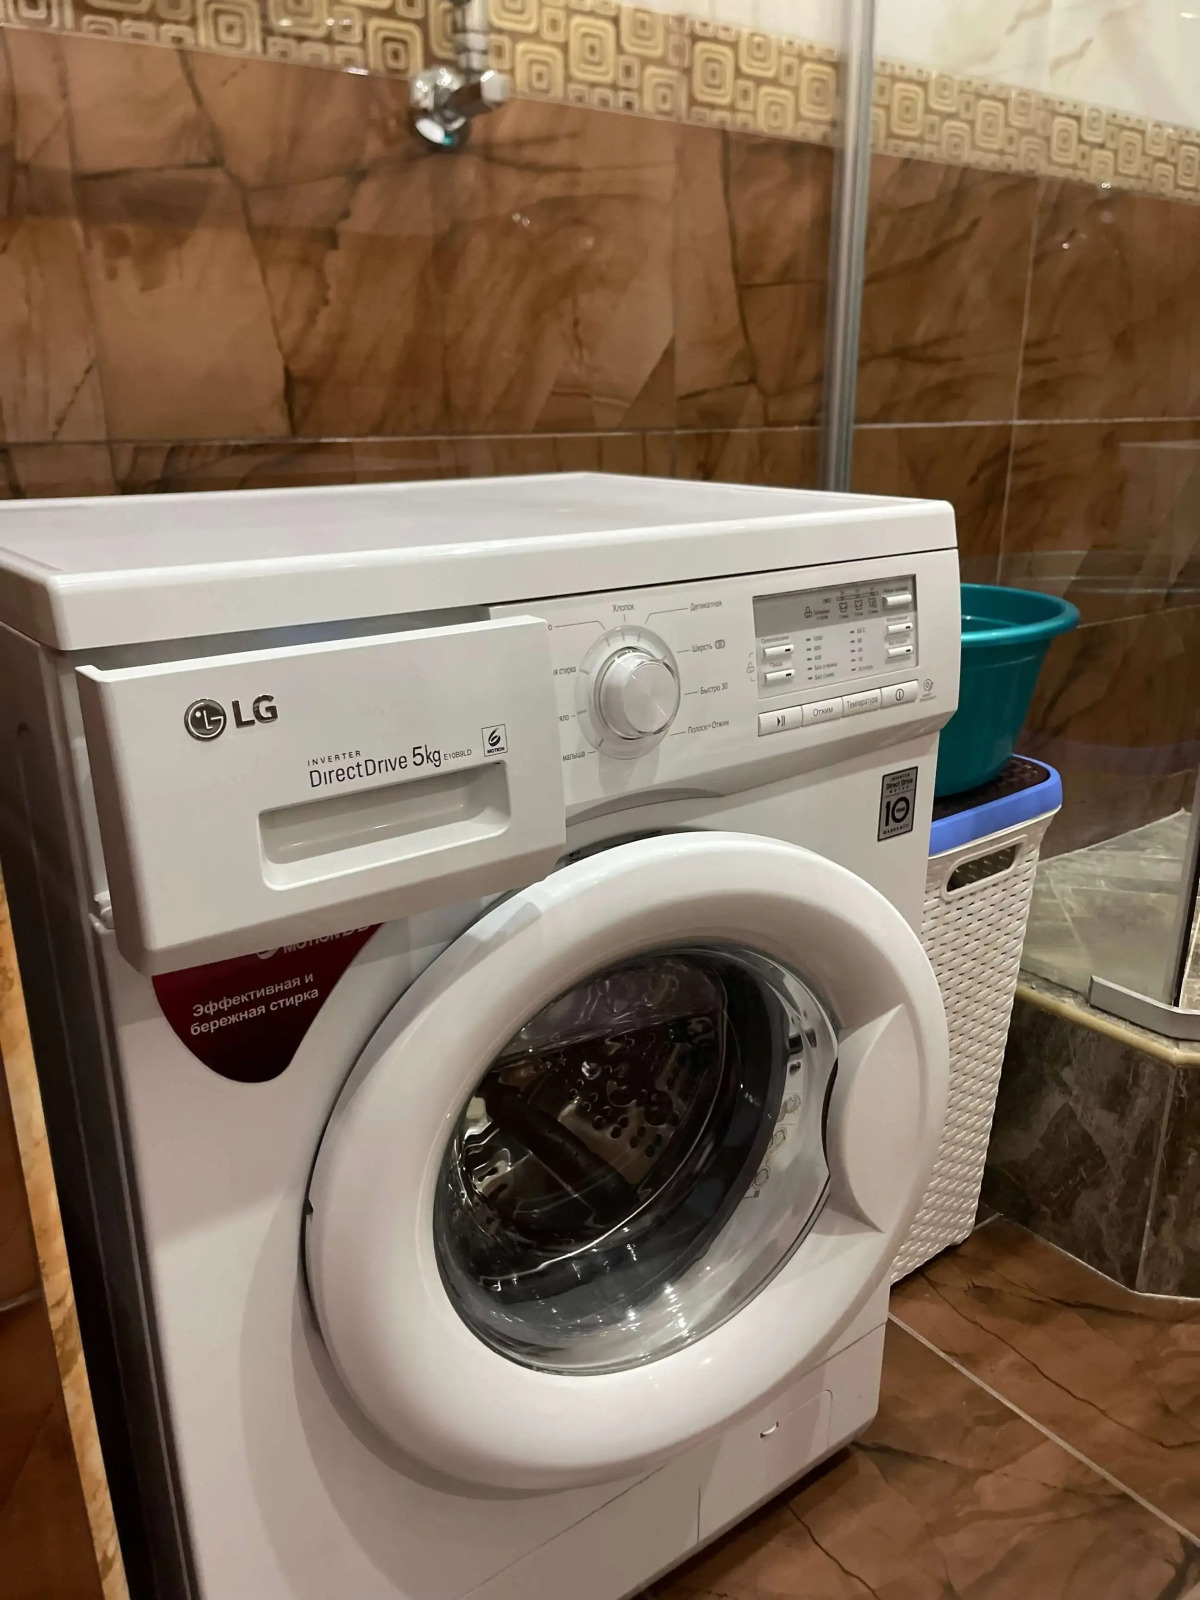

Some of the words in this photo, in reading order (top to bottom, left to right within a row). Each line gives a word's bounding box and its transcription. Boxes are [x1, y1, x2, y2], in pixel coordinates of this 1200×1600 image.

[612, 603, 635, 613] Хлопок
[690, 600, 723, 612] Деликатная
[691, 642, 713, 653] Шерсть
[700, 685, 721, 695] Быстро
[721, 682, 729, 691] 30
[846, 695, 879, 710] Температура
[231, 694, 279, 729] LG
[812, 707, 834, 717] Отжим
[412, 744, 442, 768] 5kg
[486, 746, 505, 754] MOTION
[562, 751, 586, 762] малыша
[307, 750, 362, 767] INVERTER
[884, 796, 910, 827] 10
[192, 976, 301, 1017] Эффективная
[304, 973, 314, 984] и
[190, 1004, 266, 1036] бережная
[269, 988, 319, 1014] стирка
